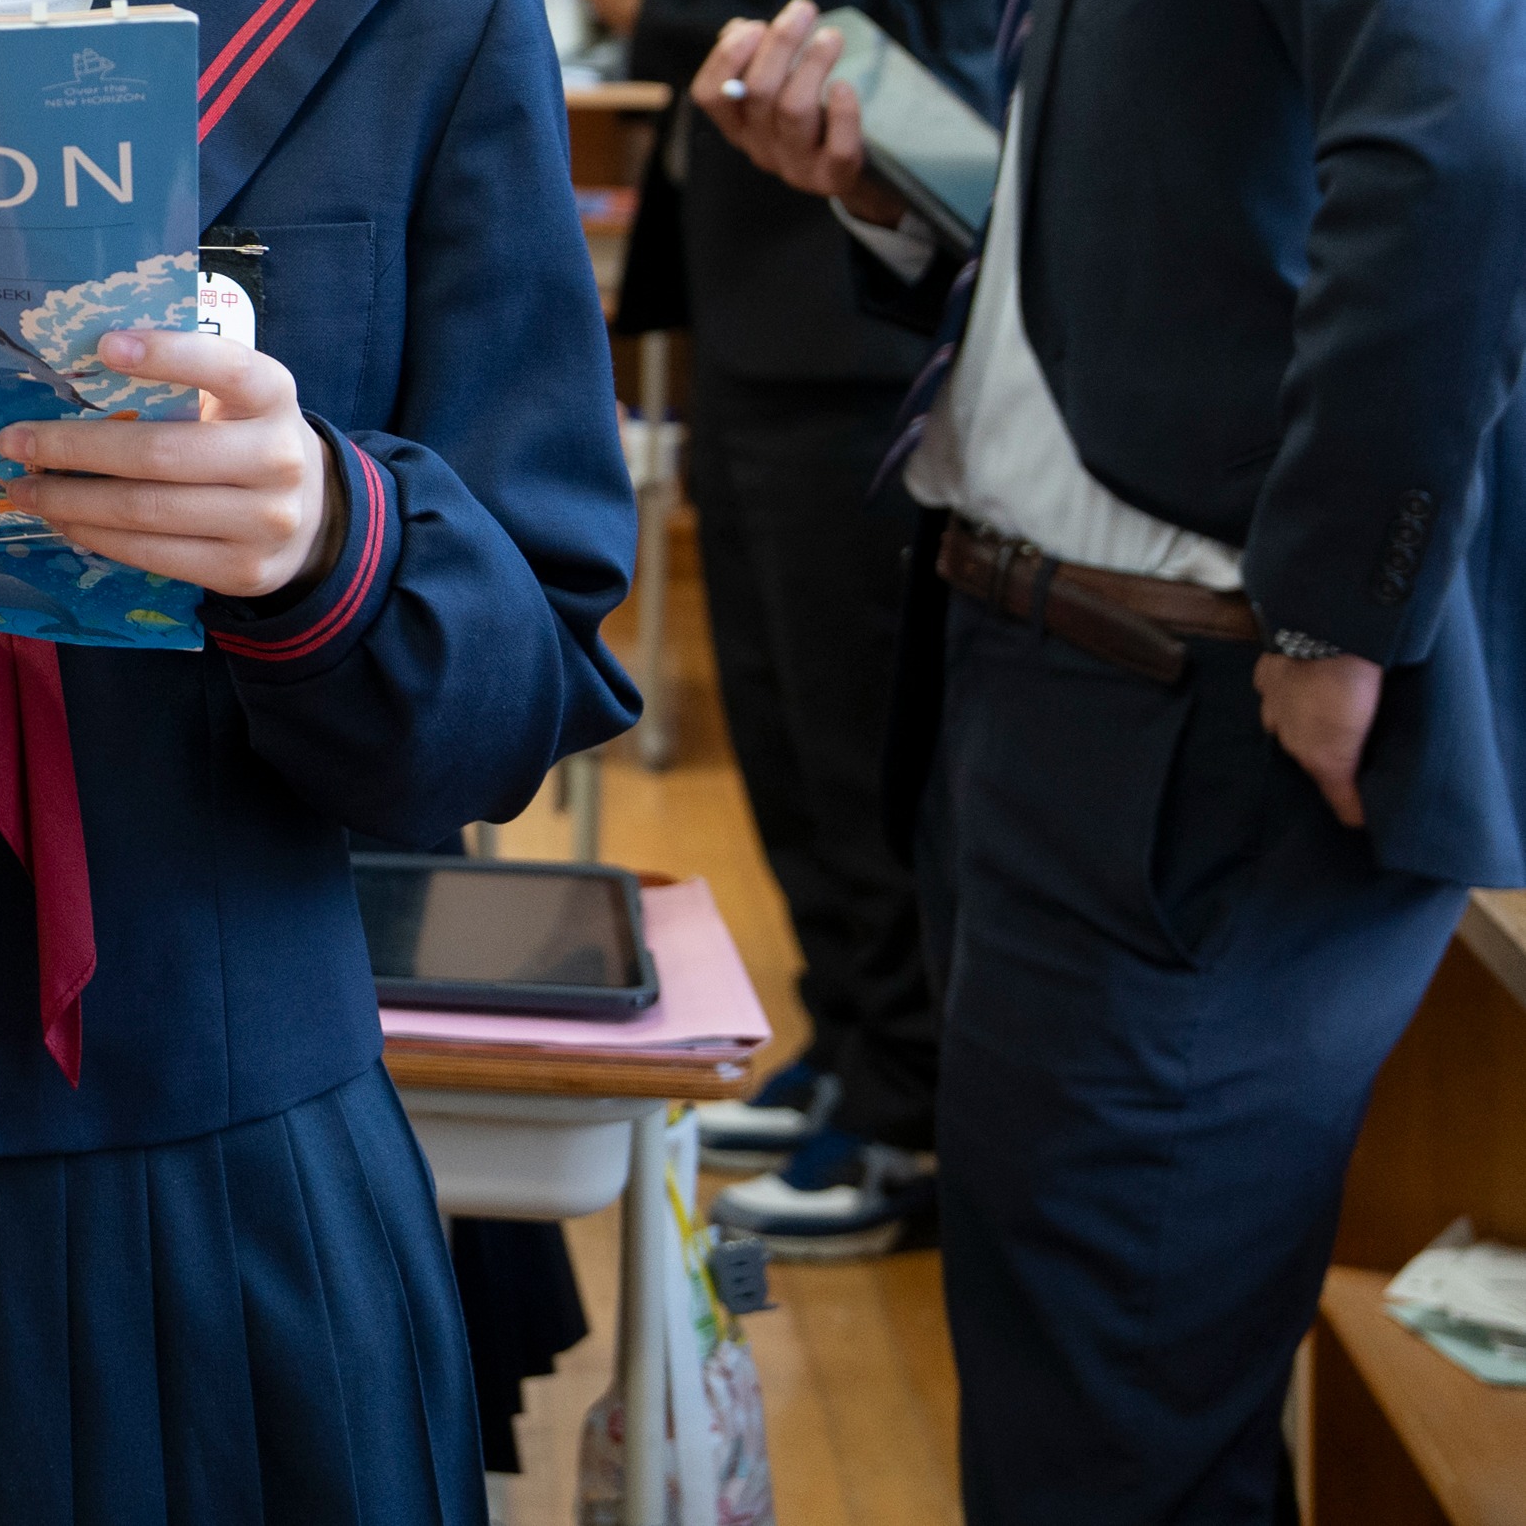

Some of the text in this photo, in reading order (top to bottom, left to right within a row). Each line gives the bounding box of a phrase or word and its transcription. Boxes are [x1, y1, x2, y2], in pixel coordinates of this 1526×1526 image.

[64, 82, 128, 97] Over the
[44, 92, 147, 108] NEW HORIZON
